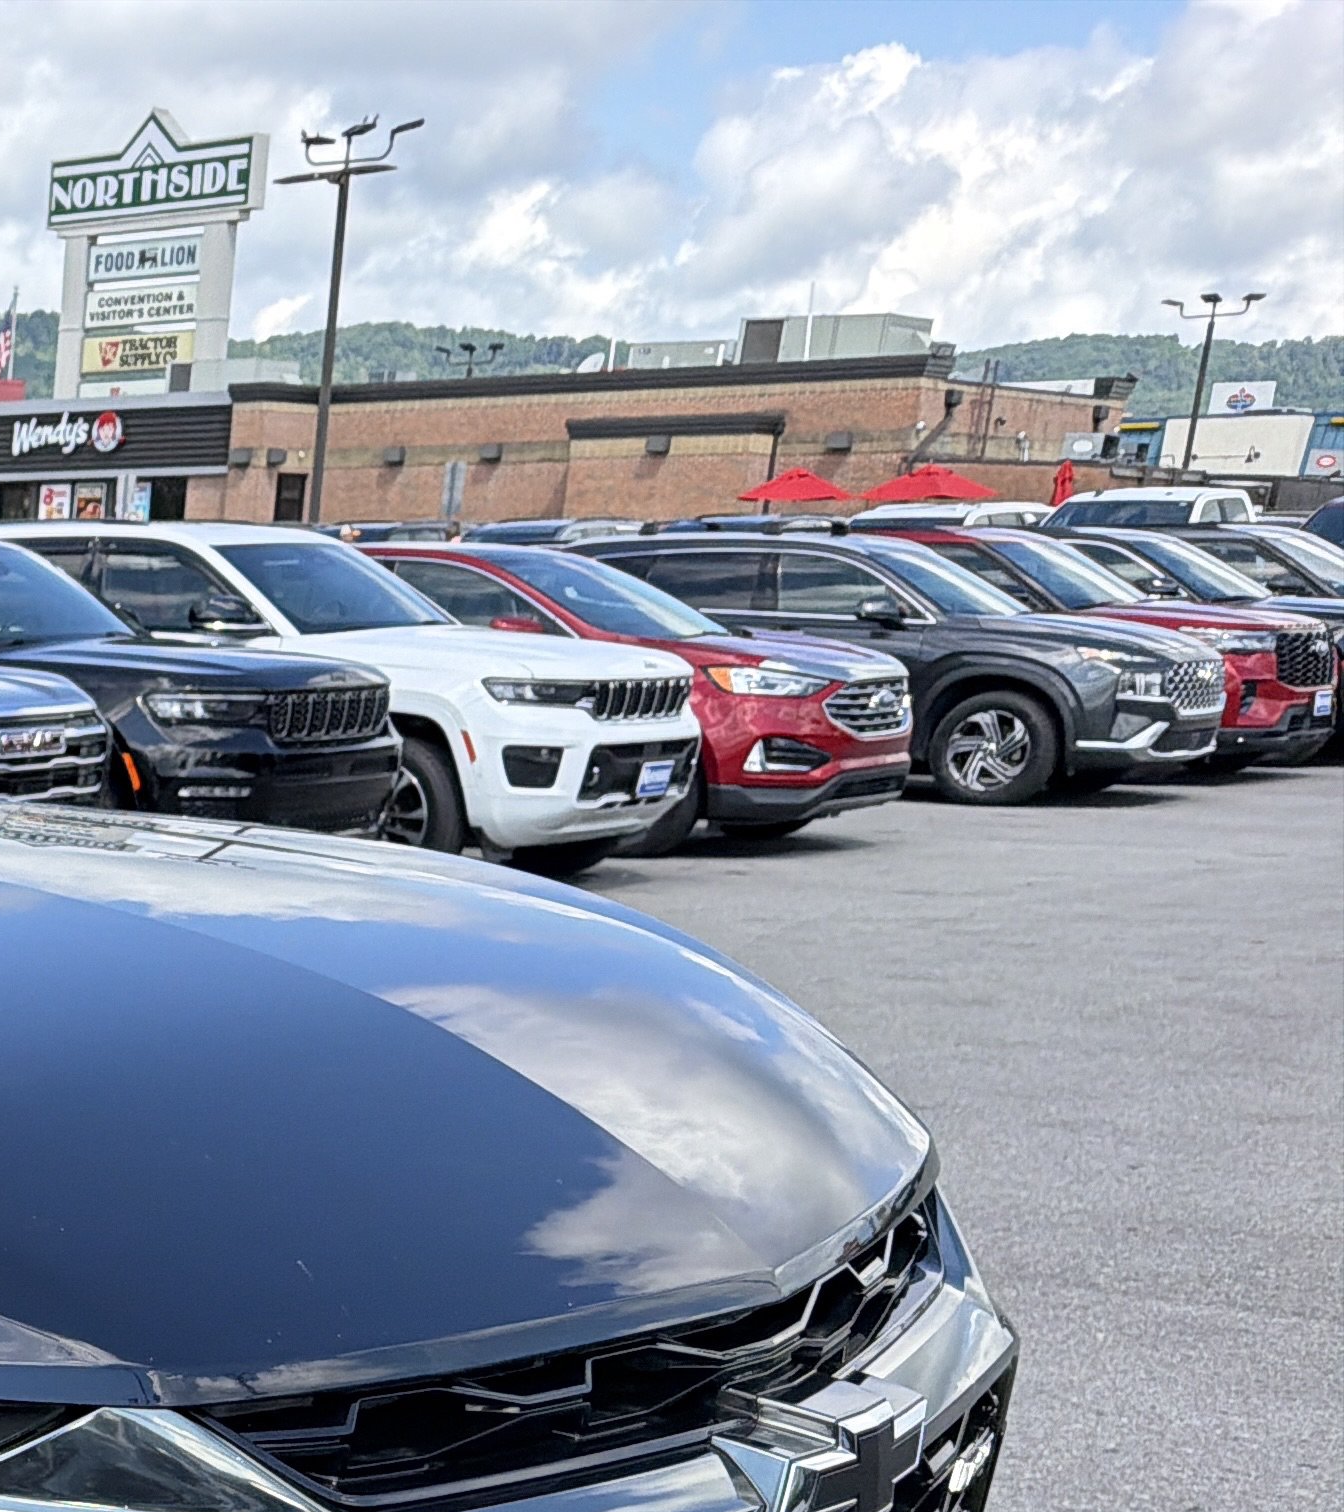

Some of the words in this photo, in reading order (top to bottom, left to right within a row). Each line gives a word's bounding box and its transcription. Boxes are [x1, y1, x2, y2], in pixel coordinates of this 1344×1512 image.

[50, 158, 248, 211] NORTHSIDE
[94, 251, 135, 274] FOOD
[160, 244, 197, 267] LION
[97, 291, 173, 309] CONVENTION
[89, 306, 144, 322] VISITOR'S
[147, 303, 194, 317] CENTER
[120, 335, 178, 353] TRACTOR
[119, 353, 162, 368] SUPPLY
[12, 411, 89, 456] Wendy's
